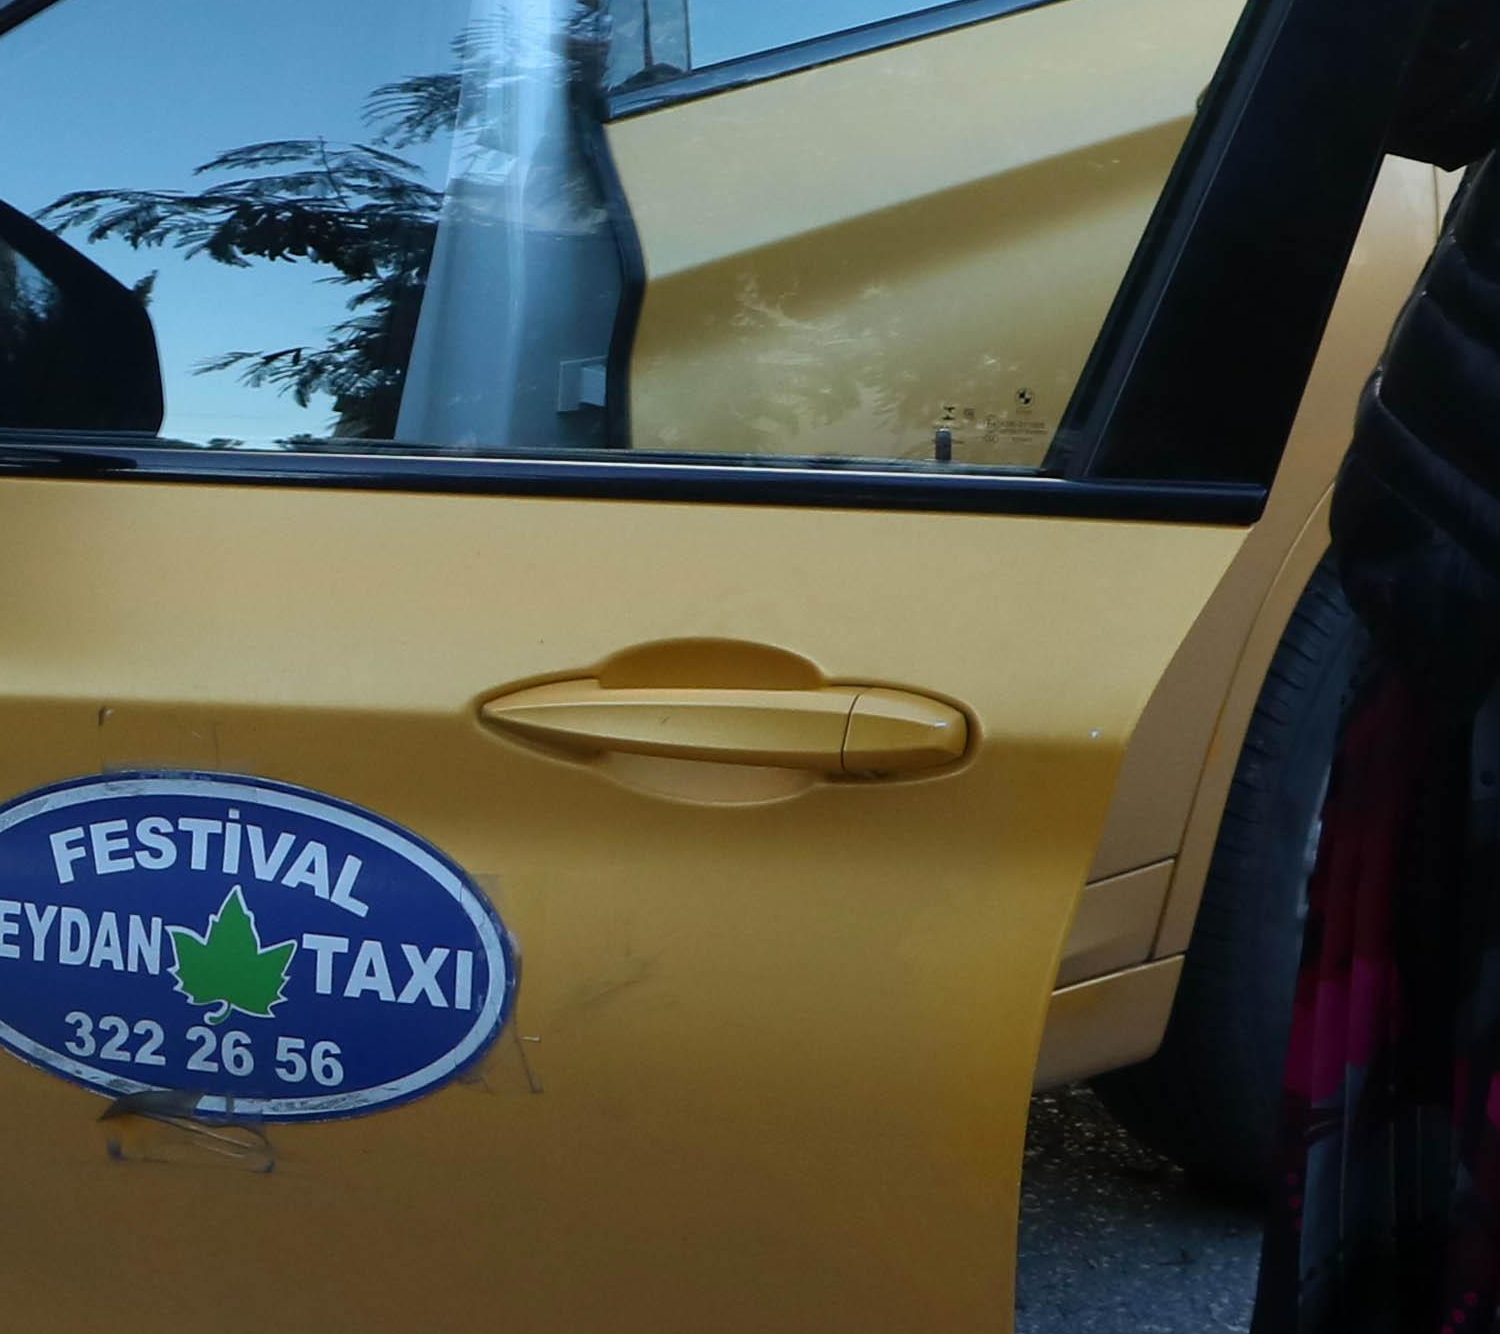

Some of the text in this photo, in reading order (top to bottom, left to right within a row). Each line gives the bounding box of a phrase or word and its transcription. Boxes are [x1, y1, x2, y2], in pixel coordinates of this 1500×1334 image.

[301, 933, 474, 1012] TAXI
[64, 1012, 345, 1087] 322 26 56
